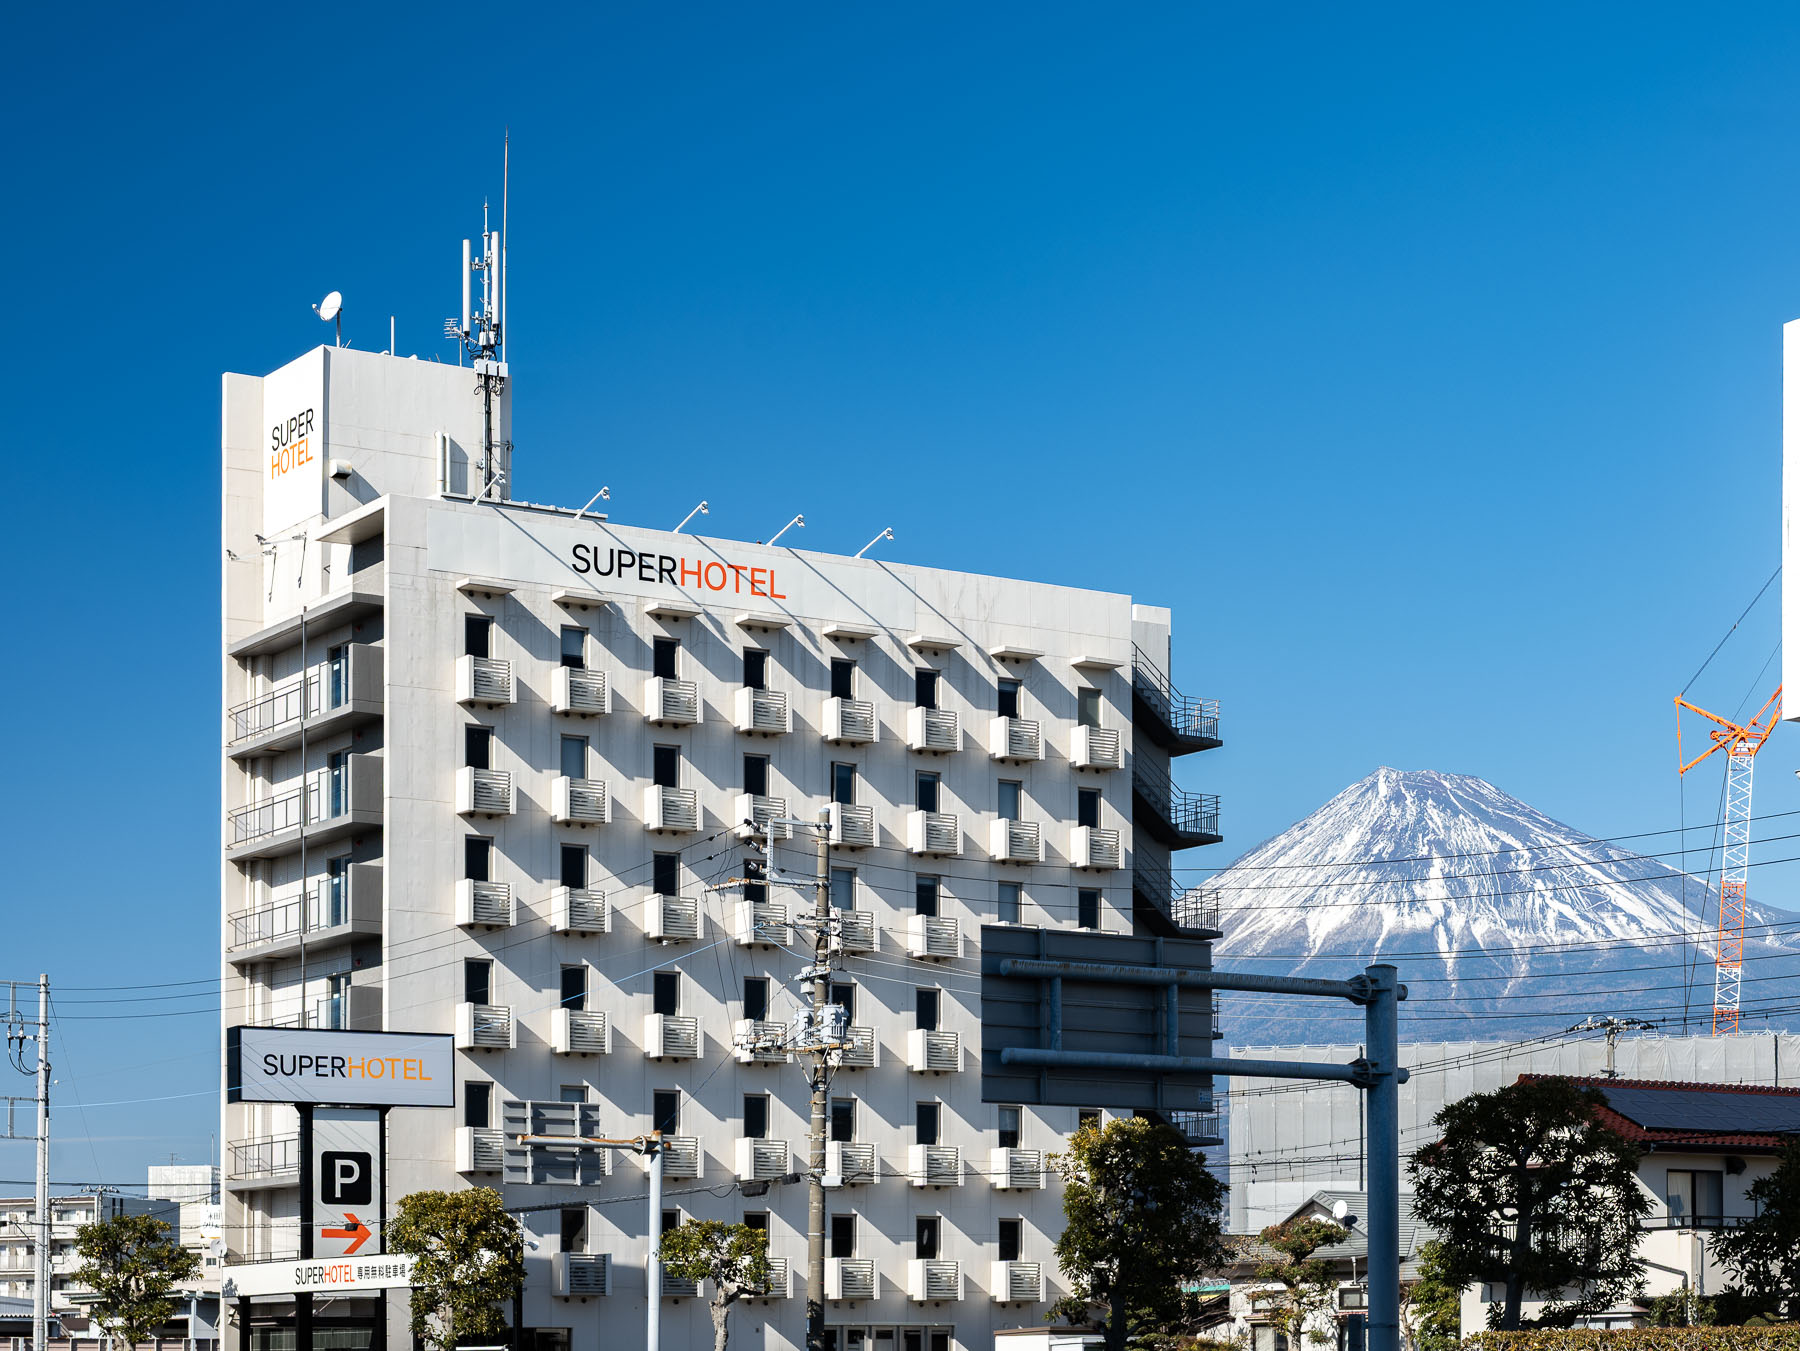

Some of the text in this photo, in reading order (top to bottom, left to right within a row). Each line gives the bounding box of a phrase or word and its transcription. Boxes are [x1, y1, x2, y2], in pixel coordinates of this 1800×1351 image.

[272, 408, 314, 452] SUPER
[271, 437, 314, 480] HOTEL
[335, 1159, 360, 1198] P
[357, 1263, 406, 1280] 専用無料駐車場
